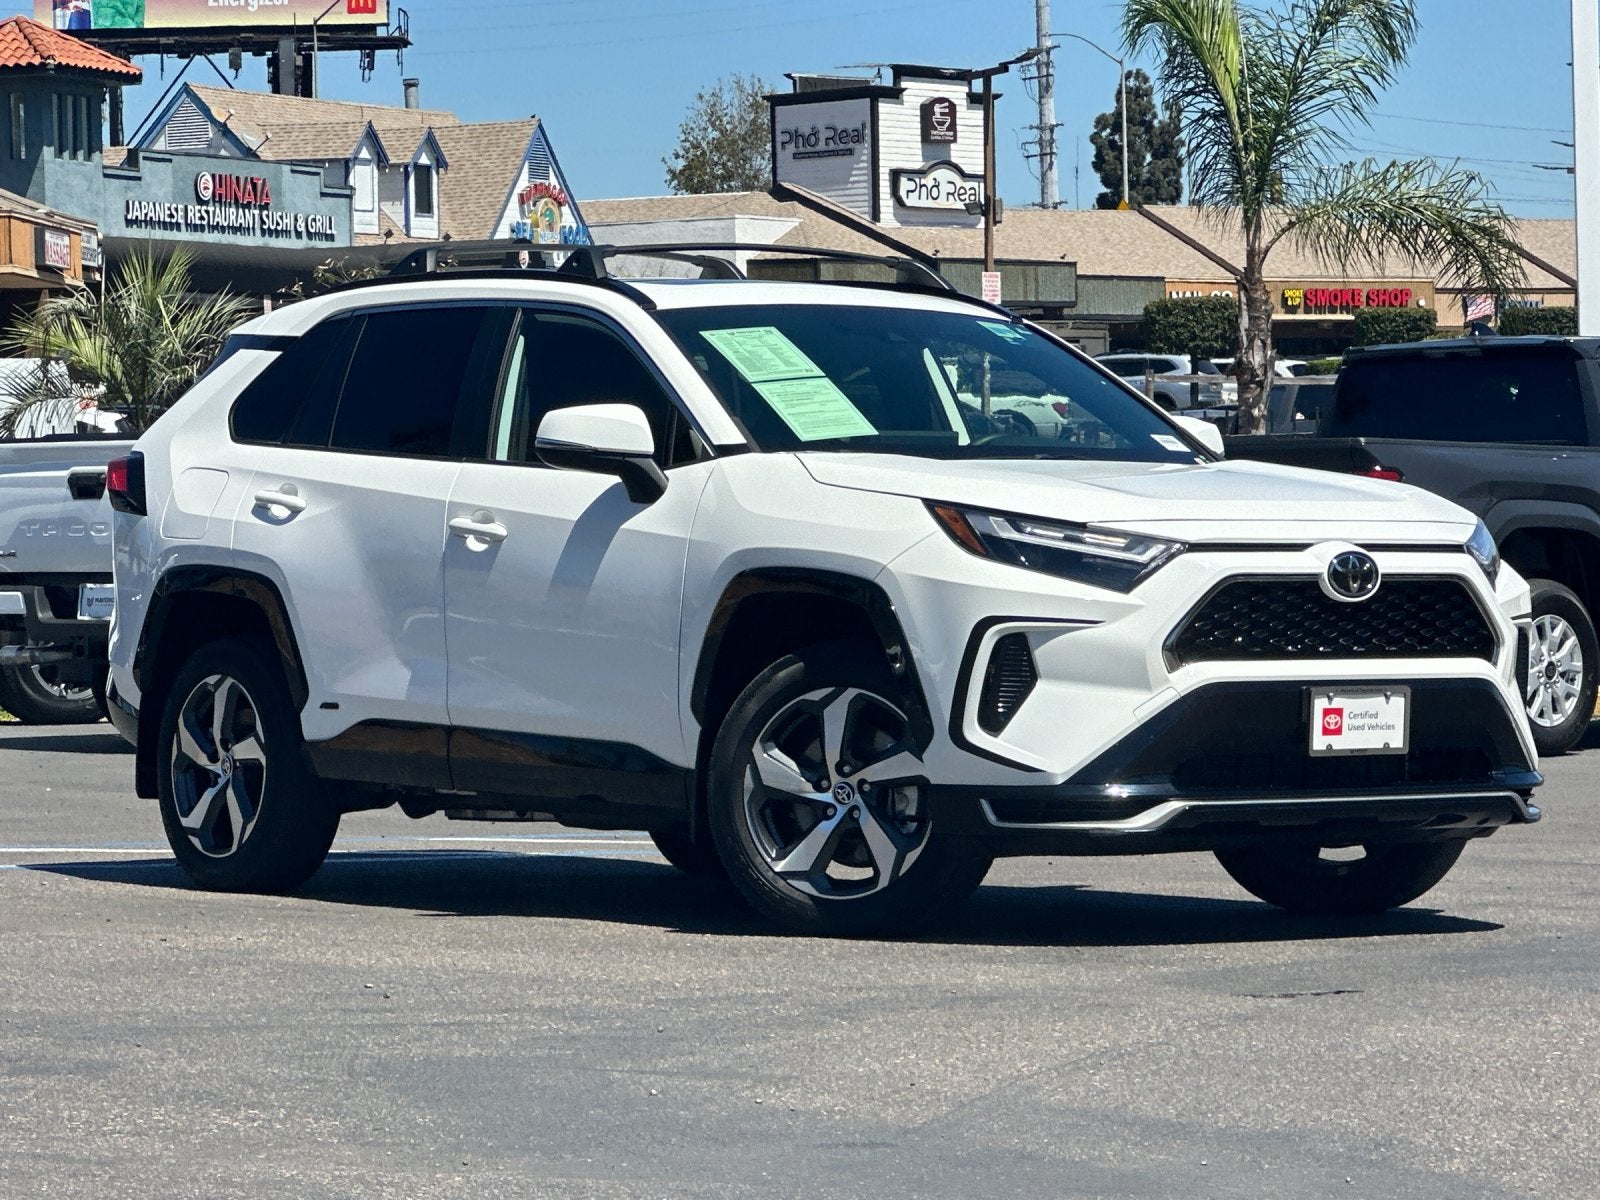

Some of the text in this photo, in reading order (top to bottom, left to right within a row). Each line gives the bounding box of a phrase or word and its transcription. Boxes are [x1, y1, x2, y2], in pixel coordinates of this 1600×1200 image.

[824, 121, 866, 147] Real
[214, 173, 272, 205] HINATA
[946, 181, 981, 202] Real
[127, 200, 337, 235] JAPANESE RESTAURANT SUSHI & GRILL
[1306, 288, 1412, 307] SMOKE SHOP
[1348, 711, 1379, 720] Certified
[1347, 722, 1396, 731] Used Vehicles
